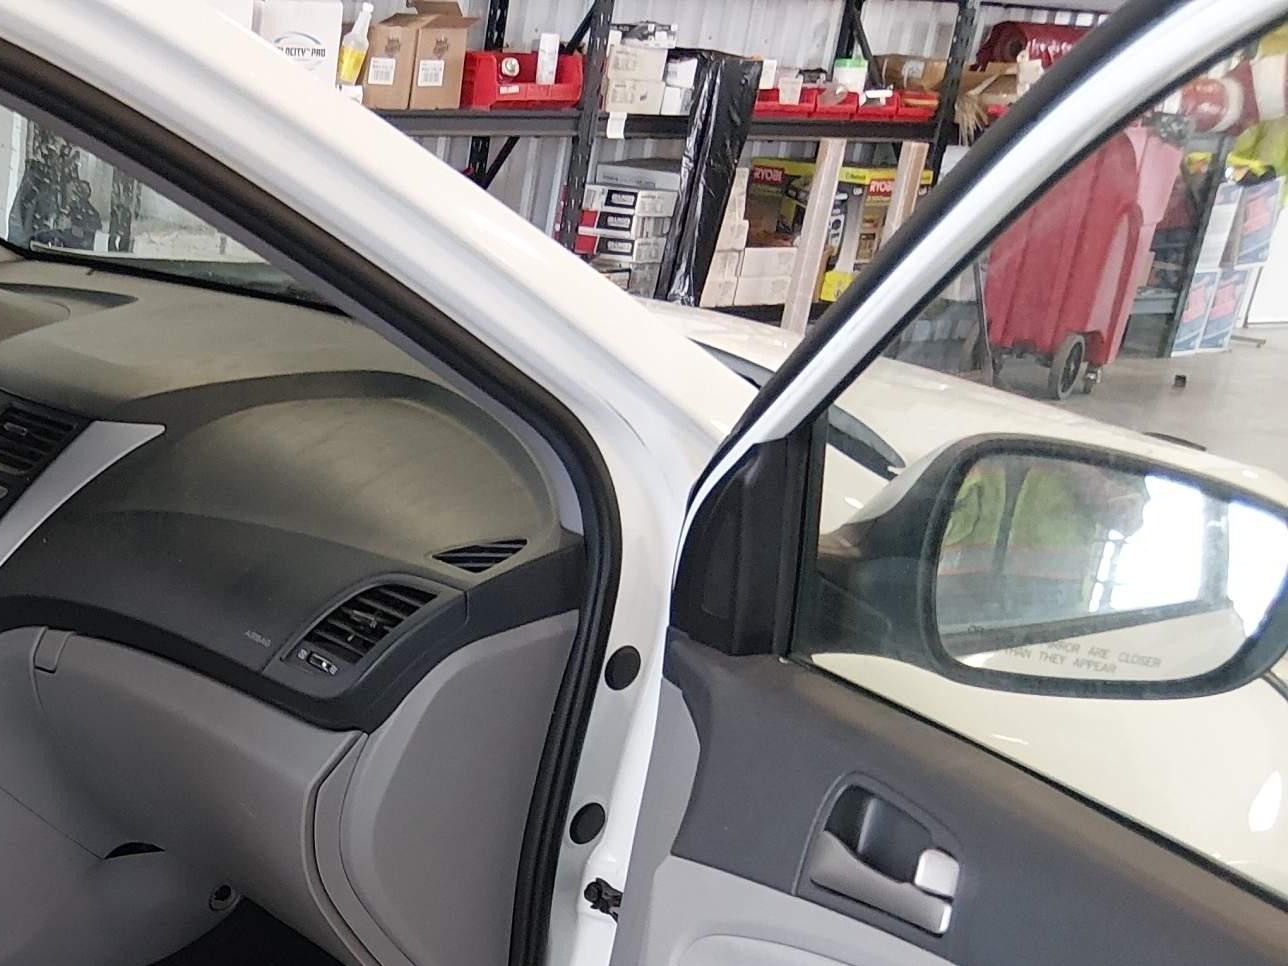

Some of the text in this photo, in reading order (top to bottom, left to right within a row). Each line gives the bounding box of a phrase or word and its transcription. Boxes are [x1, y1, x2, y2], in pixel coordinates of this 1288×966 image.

[753, 167, 783, 182] RYOBI
[1088, 645, 1111, 659] ARE
[1039, 651, 1067, 665] THEY
[1073, 657, 1117, 673] APPEAR
